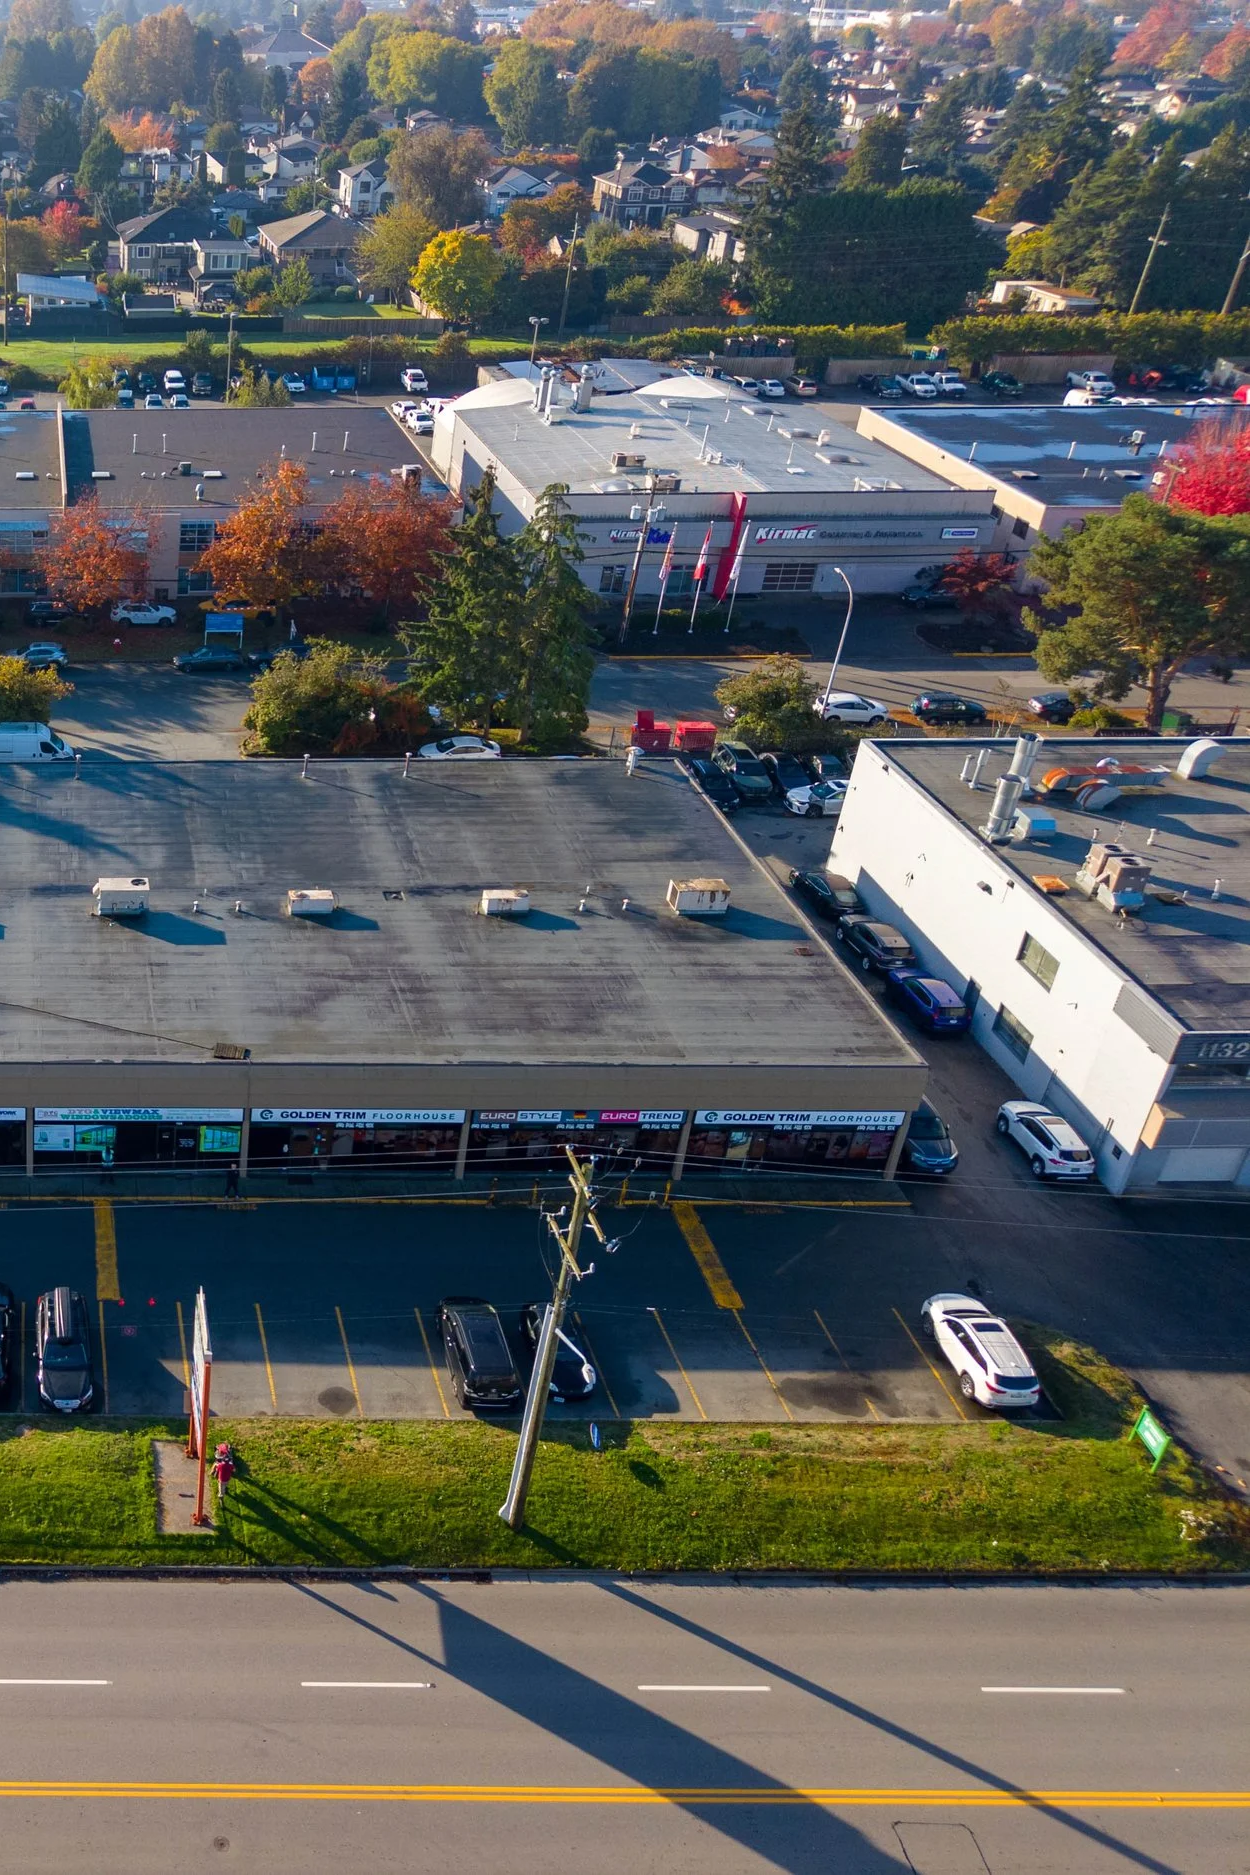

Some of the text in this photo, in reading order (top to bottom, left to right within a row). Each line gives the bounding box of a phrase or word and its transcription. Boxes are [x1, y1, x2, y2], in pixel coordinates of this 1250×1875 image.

[755, 527, 817, 540] Kirmac
[280, 1111, 331, 1120] GOLDEN
[334, 1111, 366, 1120] TRIM
[480, 1112, 561, 1120] EURO STYLE
[601, 1112, 682, 1120] EURO TREND
[723, 1113, 776, 1122] GOLDEN
[778, 1113, 811, 1122] TRIM
